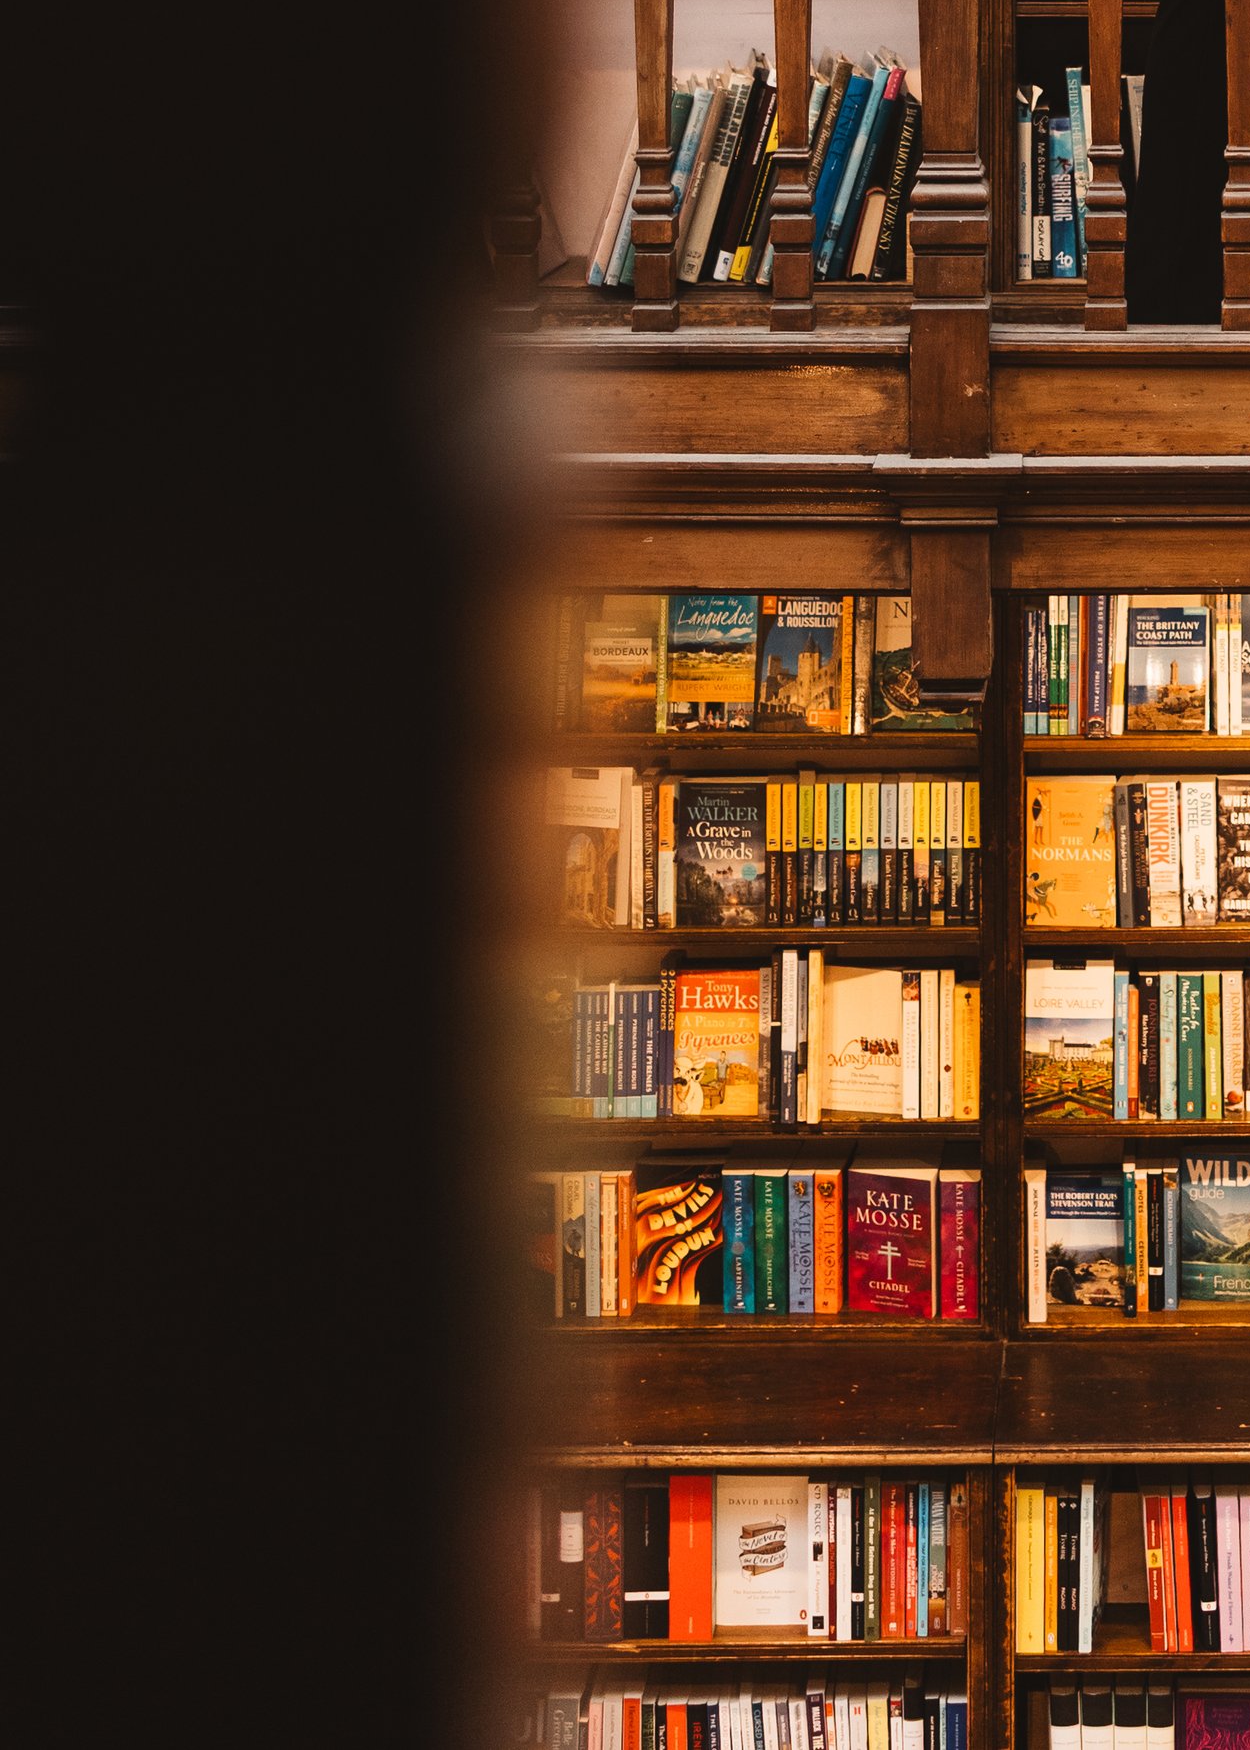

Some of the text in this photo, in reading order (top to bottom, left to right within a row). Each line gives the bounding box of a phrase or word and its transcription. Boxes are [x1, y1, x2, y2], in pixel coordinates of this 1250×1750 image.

[1067, 78, 1083, 142] SHIP IN THE
[809, 87, 844, 168] The Most Beautiful
[1036, 142, 1044, 155] Mr
[1036, 164, 1045, 181] Mrs
[1037, 182, 1046, 206] Smith
[1050, 173, 1072, 221] SURFING
[778, 602, 844, 616] LANGUEDOC
[678, 607, 755, 640] Languedoc
[777, 617, 838, 629] & ROUSSILLON
[1136, 621, 1200, 630] THE BRITTANY
[1136, 631, 1192, 640] COAST PATH
[593, 647, 649, 657] BORDEAUX
[697, 796, 730, 807] Martin
[1187, 787, 1198, 832] & STEEL
[1200, 792, 1212, 826] SAND
[687, 806, 758, 821] WALKER
[686, 823, 751, 838] A Grave in
[1149, 787, 1170, 865] DUNKIRK
[721, 838, 734, 848] the
[1060, 836, 1084, 845] THE
[696, 842, 753, 860] Woods
[1031, 847, 1111, 862] NORMANS
[705, 981, 734, 994] Tony
[680, 986, 759, 1010] Hawks
[1034, 998, 1105, 1009] LOIRE VALLEY
[678, 1030, 756, 1052] Pyrenees
[645, 1040, 653, 1092] THE PYRENEES
[866, 1191, 914, 1211] KATE
[1095, 1192, 1118, 1200] LOUIS
[1189, 1187, 1225, 1201] guide
[649, 1184, 715, 1231] DEVILS
[734, 1180, 743, 1239] KATE MOSSE
[764, 1180, 773, 1239] KATE MOSSE
[1050, 1199, 1115, 1208] STEVENSON TRAIL
[855, 1208, 923, 1230] MOSSE
[955, 1183, 964, 1303] KATE MOSSE CITADEL
[654, 1226, 715, 1295] LOUDUN
[735, 1257, 743, 1301] LABYRINTH
[868, 1280, 911, 1294] CITADEL
[763, 1497, 800, 1505] BELLOS
